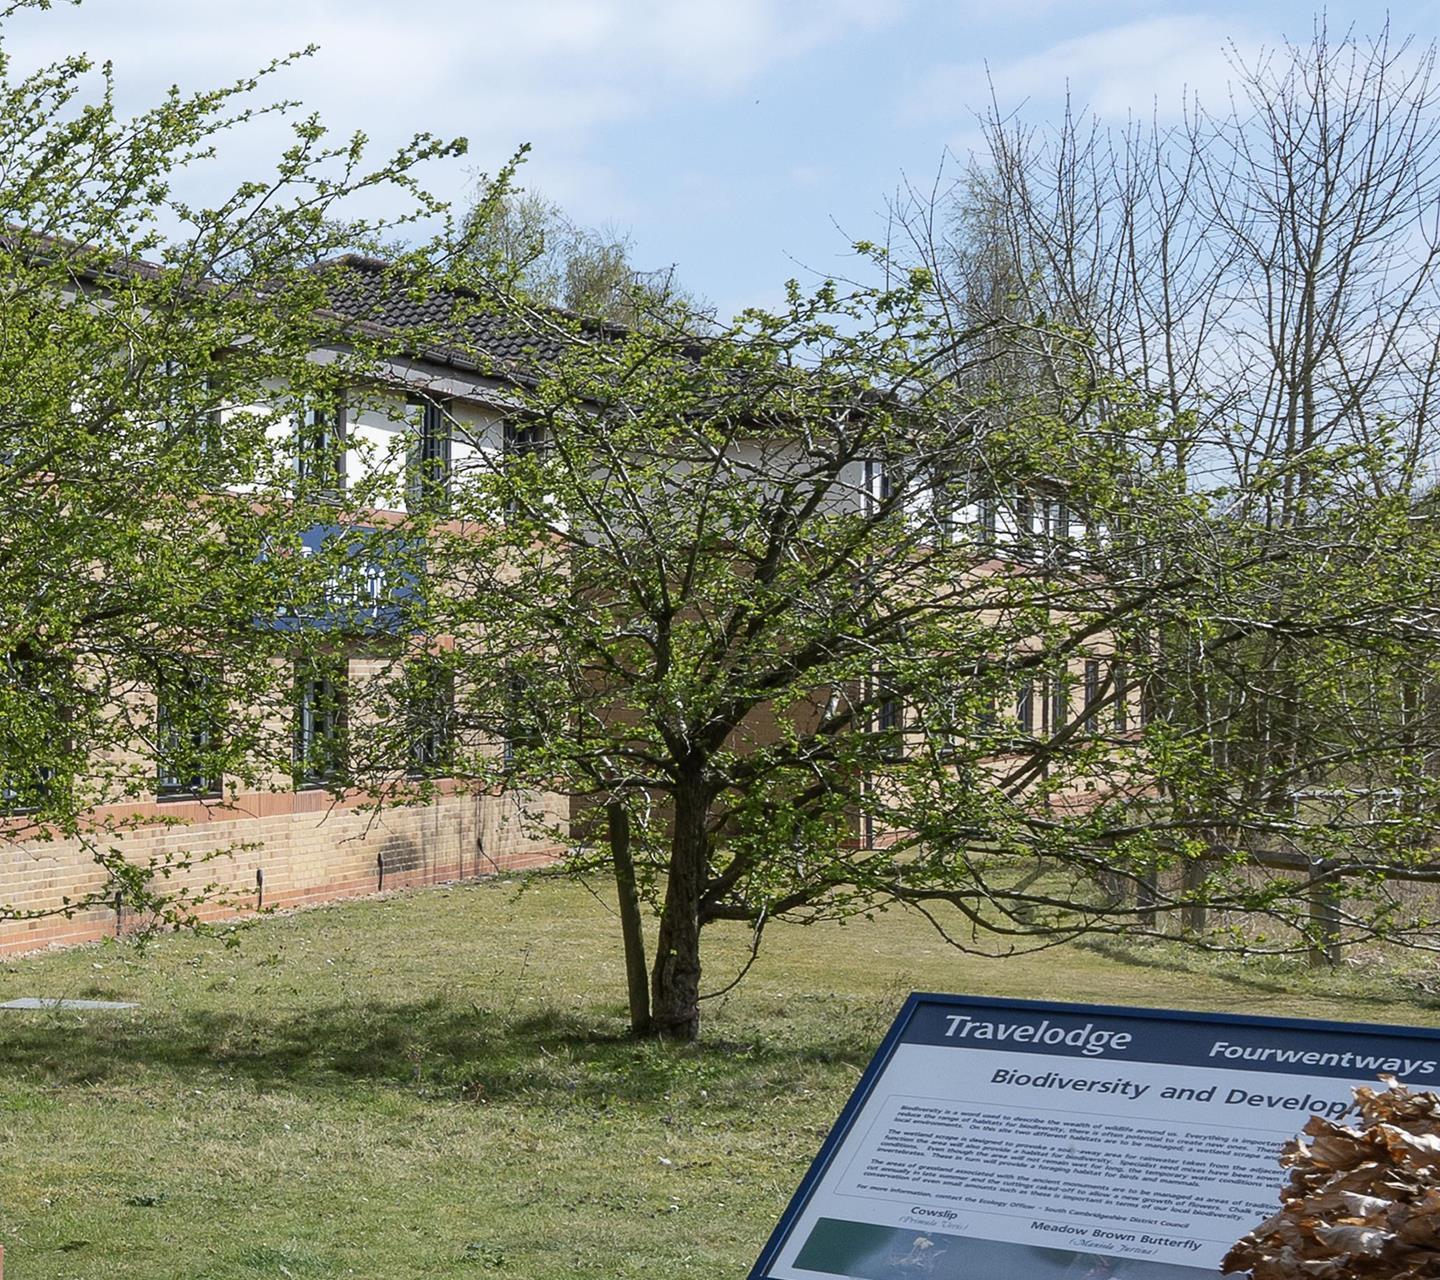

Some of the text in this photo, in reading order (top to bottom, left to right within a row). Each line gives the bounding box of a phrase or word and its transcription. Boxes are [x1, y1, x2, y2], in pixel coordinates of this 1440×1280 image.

[944, 1015, 1438, 1077] Travelodge Fourwentways
[991, 1070, 1348, 1116] Biodiversity and Develop
[910, 1206, 958, 1220] Cowslip
[1030, 1221, 1202, 1251] Meadow Brown Butterfly
